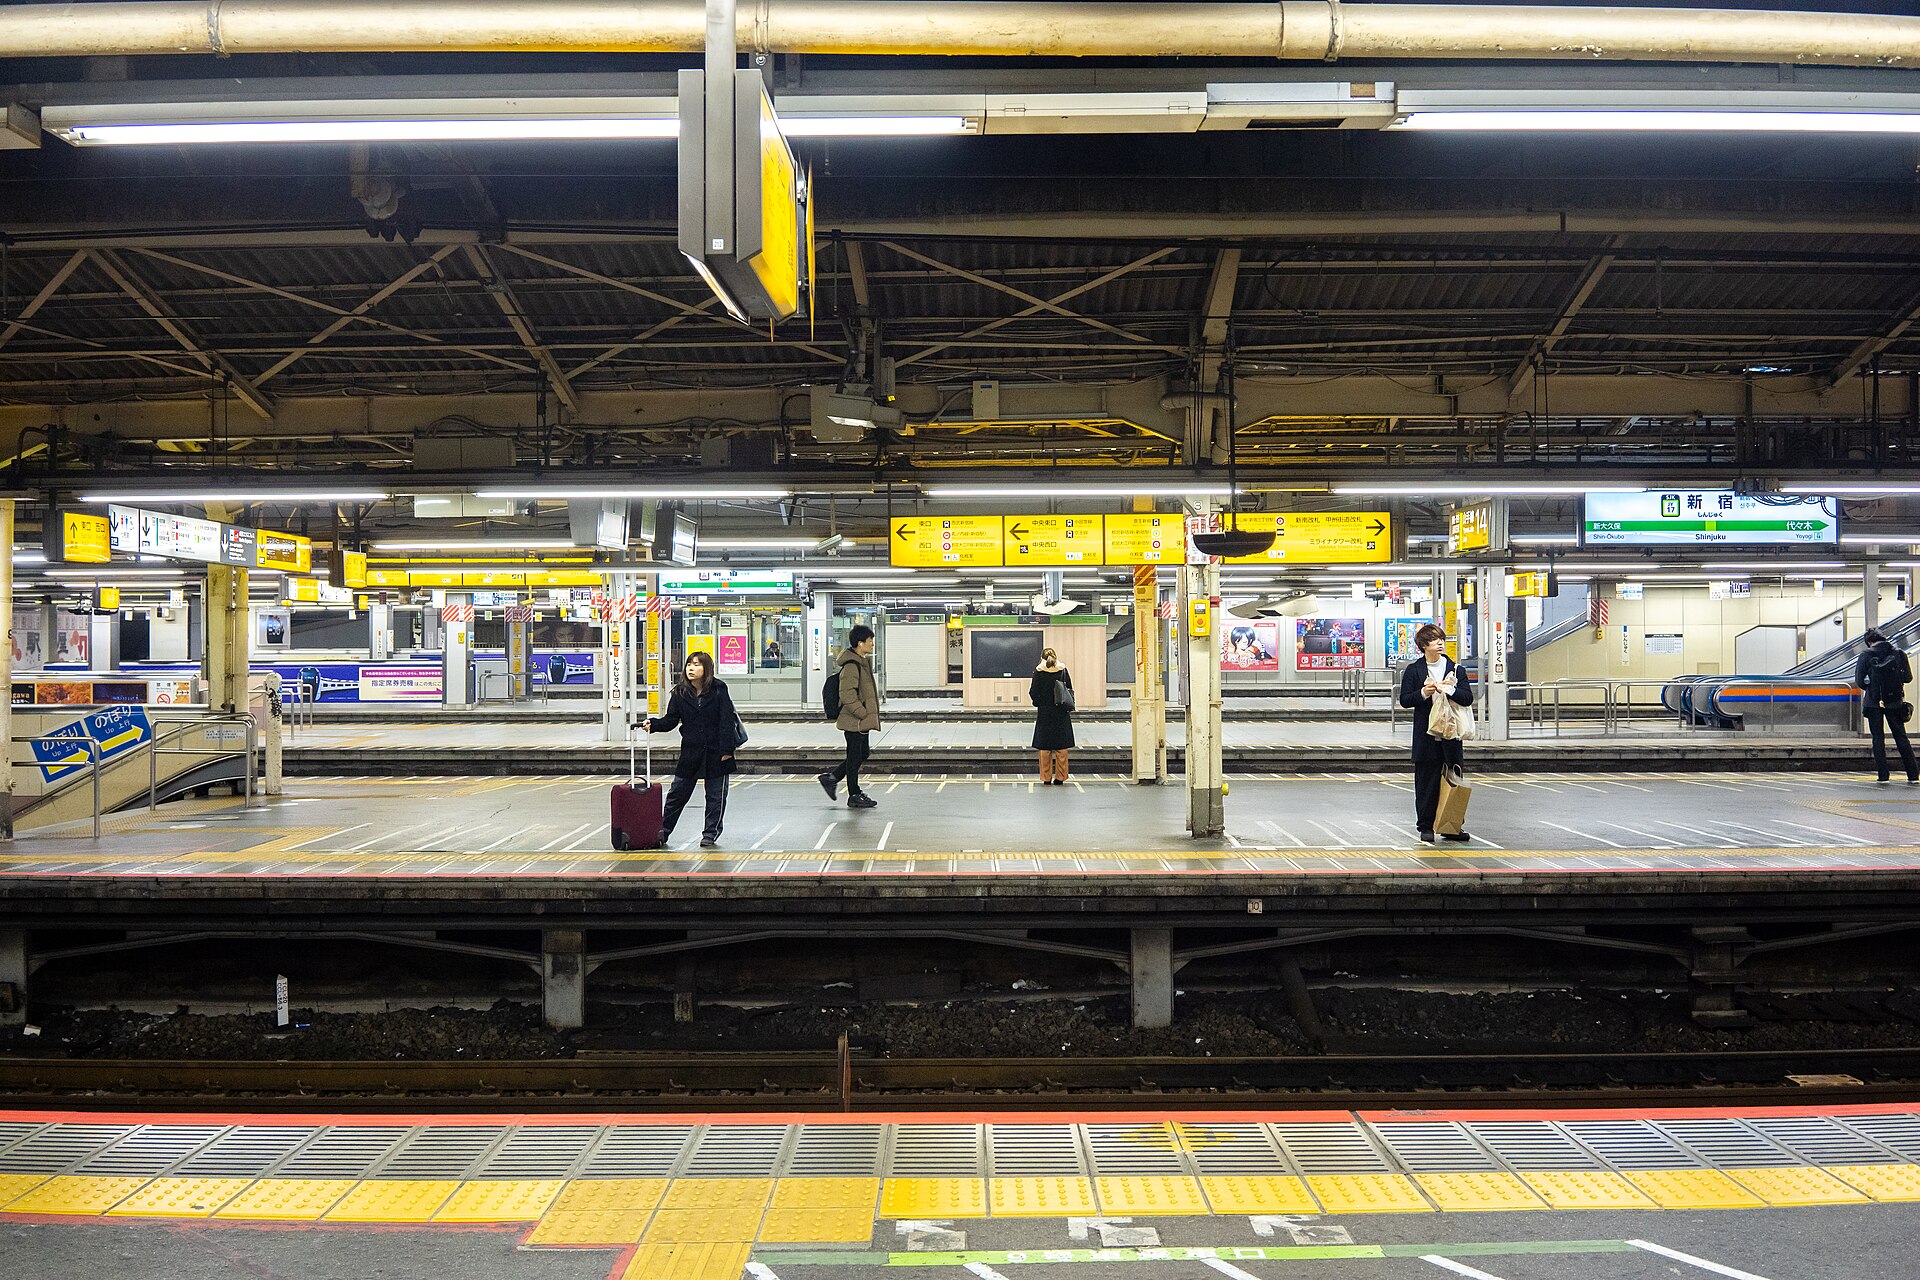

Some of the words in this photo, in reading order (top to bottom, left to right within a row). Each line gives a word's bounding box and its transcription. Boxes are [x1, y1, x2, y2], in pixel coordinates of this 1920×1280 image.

[1194, 501, 1202, 510] 3
[1687, 494, 1733, 509] 新宿
[1475, 507, 1488, 534] 14
[1786, 521, 1813, 530] 代々木
[94, 706, 132, 728] のぼり
[118, 720, 131, 730] 上行
[66, 743, 77, 752] 上行
